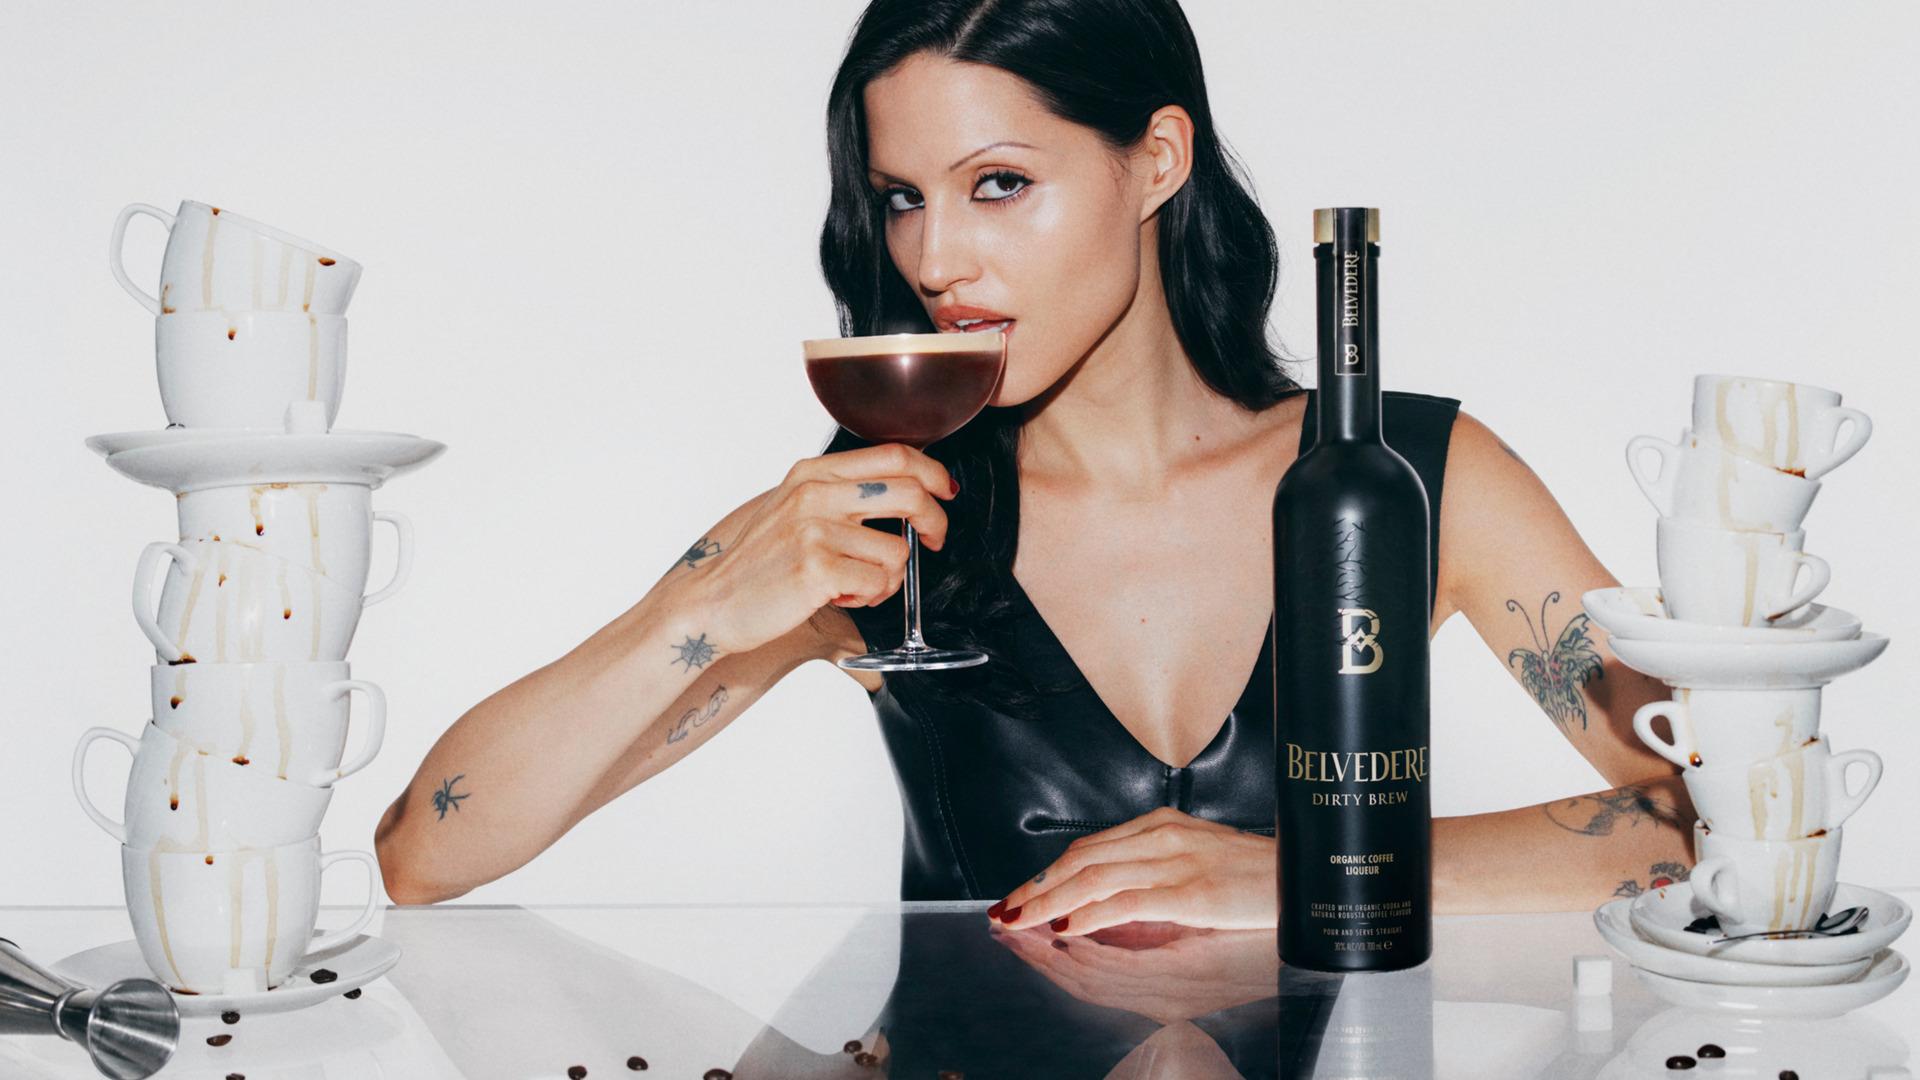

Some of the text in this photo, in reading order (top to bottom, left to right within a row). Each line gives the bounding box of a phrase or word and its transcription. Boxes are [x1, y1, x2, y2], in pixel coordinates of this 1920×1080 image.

[1341, 250, 1360, 328] BELVEDERE
[1337, 608, 1384, 675] B
[1286, 743, 1428, 783] BELVEDERE
[1312, 791, 1409, 806] DIRTY BREW
[1330, 853, 1394, 865] ORGANIC COFFEE
[1345, 865, 1380, 876] LIQUEUR
[1311, 902, 1336, 912] CRAFTED
[1338, 904, 1353, 912] WITH
[1354, 903, 1381, 912] ORGANIC
[1311, 910, 1336, 919] NATURAL
[1366, 911, 1388, 919] COFFEE
[1323, 926, 1402, 936] POUR AND SERVE STRAIGHT
